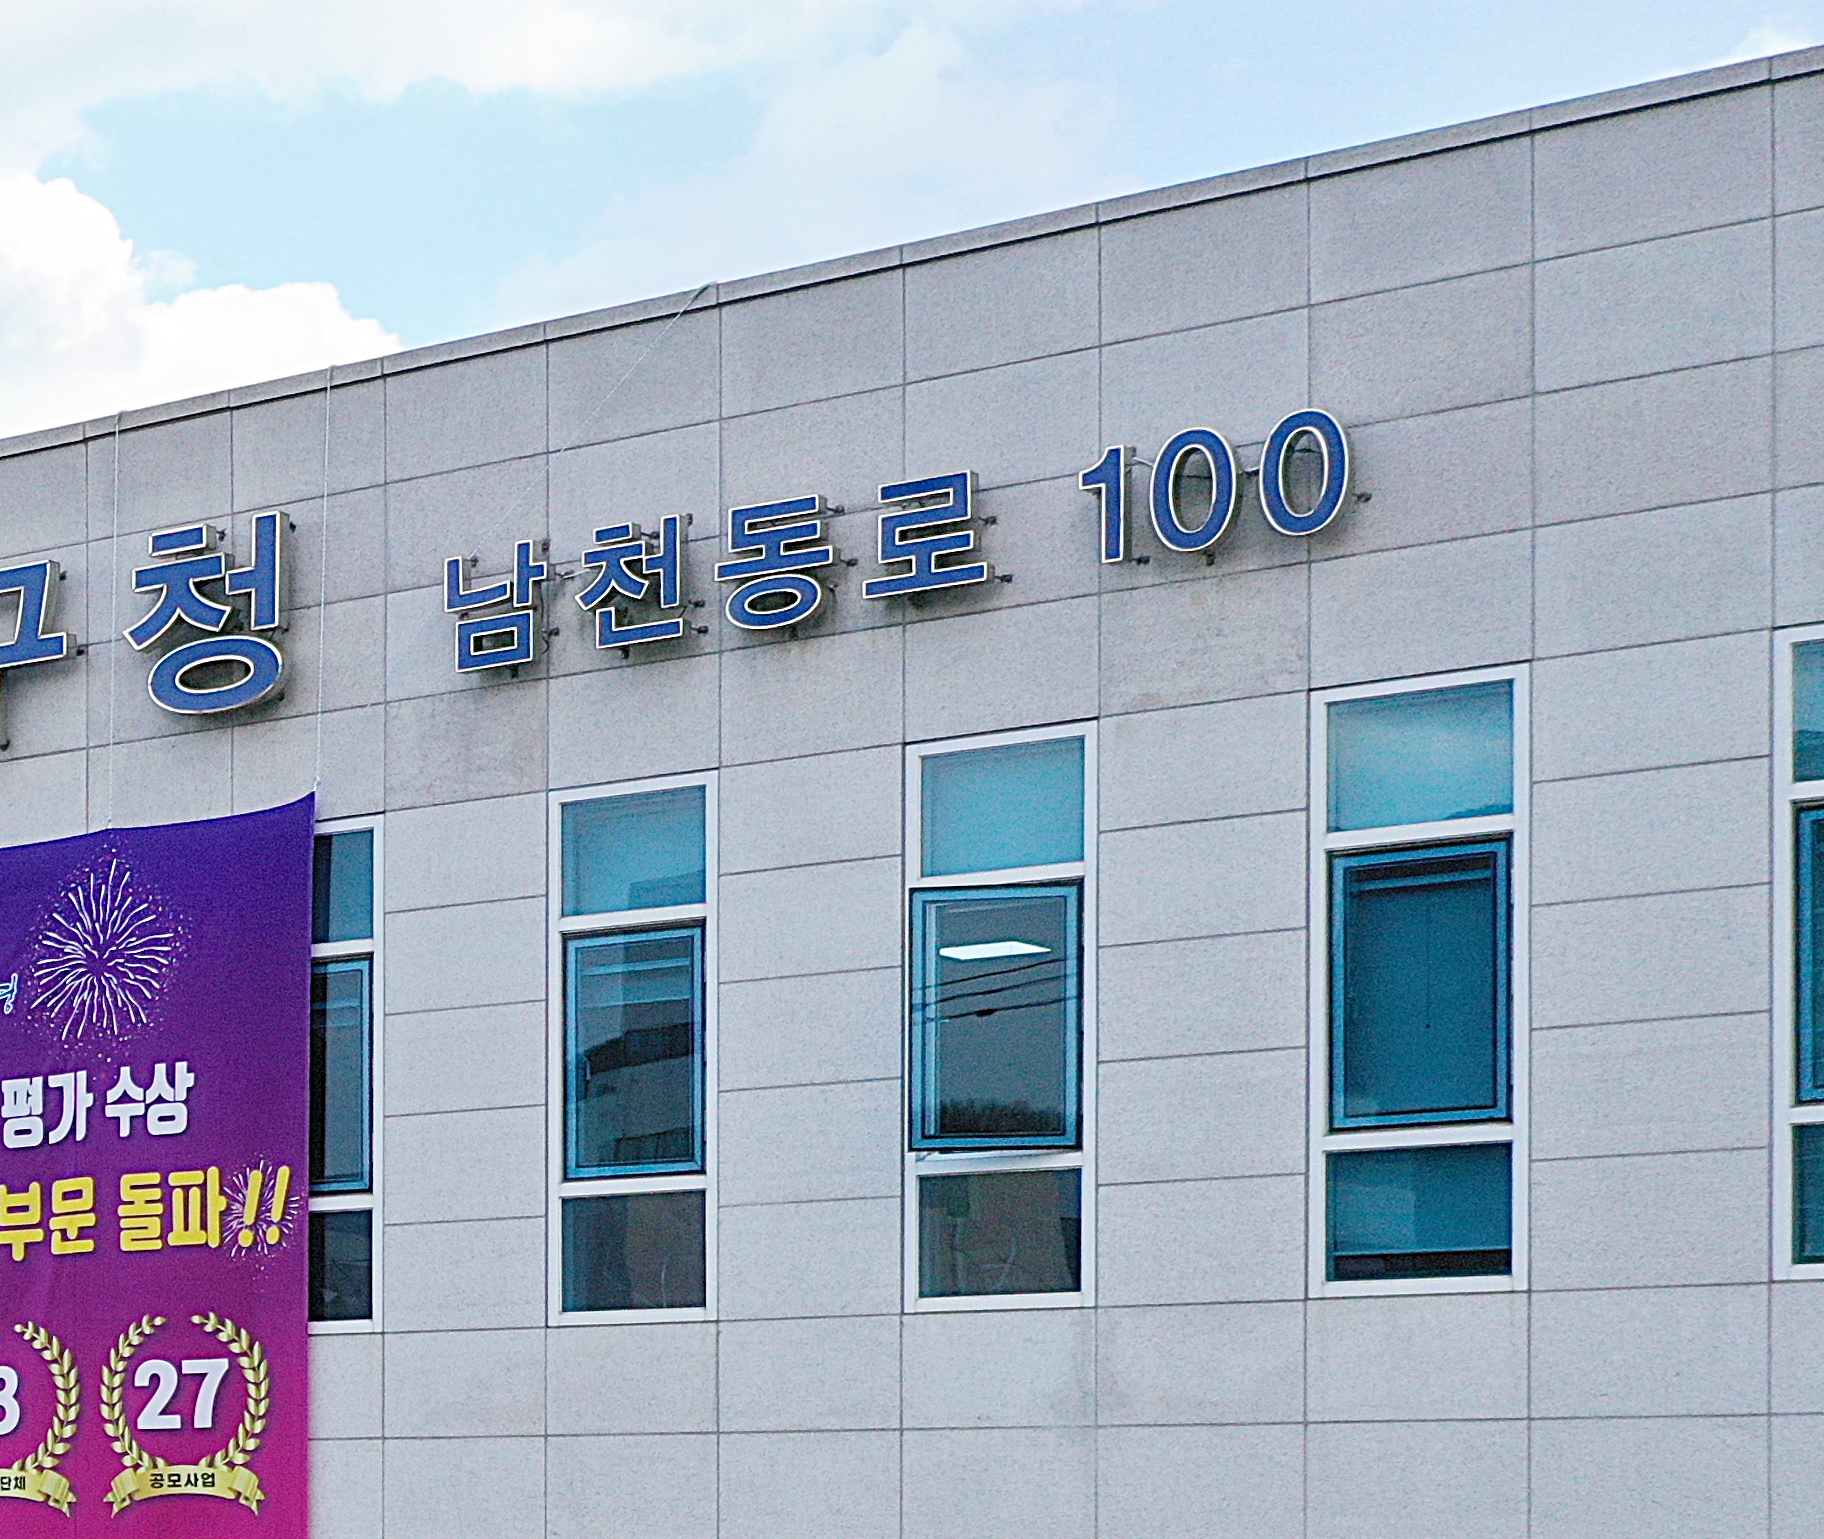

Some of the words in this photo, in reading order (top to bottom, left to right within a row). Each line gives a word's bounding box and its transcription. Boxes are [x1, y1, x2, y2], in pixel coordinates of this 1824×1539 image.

[443, 469, 995, 676] 남천동로
[1077, 404, 1352, 566] 100
[0, 1072, 94, 1151] 평가
[105, 1061, 197, 1137] 수상
[117, 1163, 291, 1254] 돌파!!
[132, 1359, 230, 1430] 27
[149, 1471, 217, 1489] 공모사업
